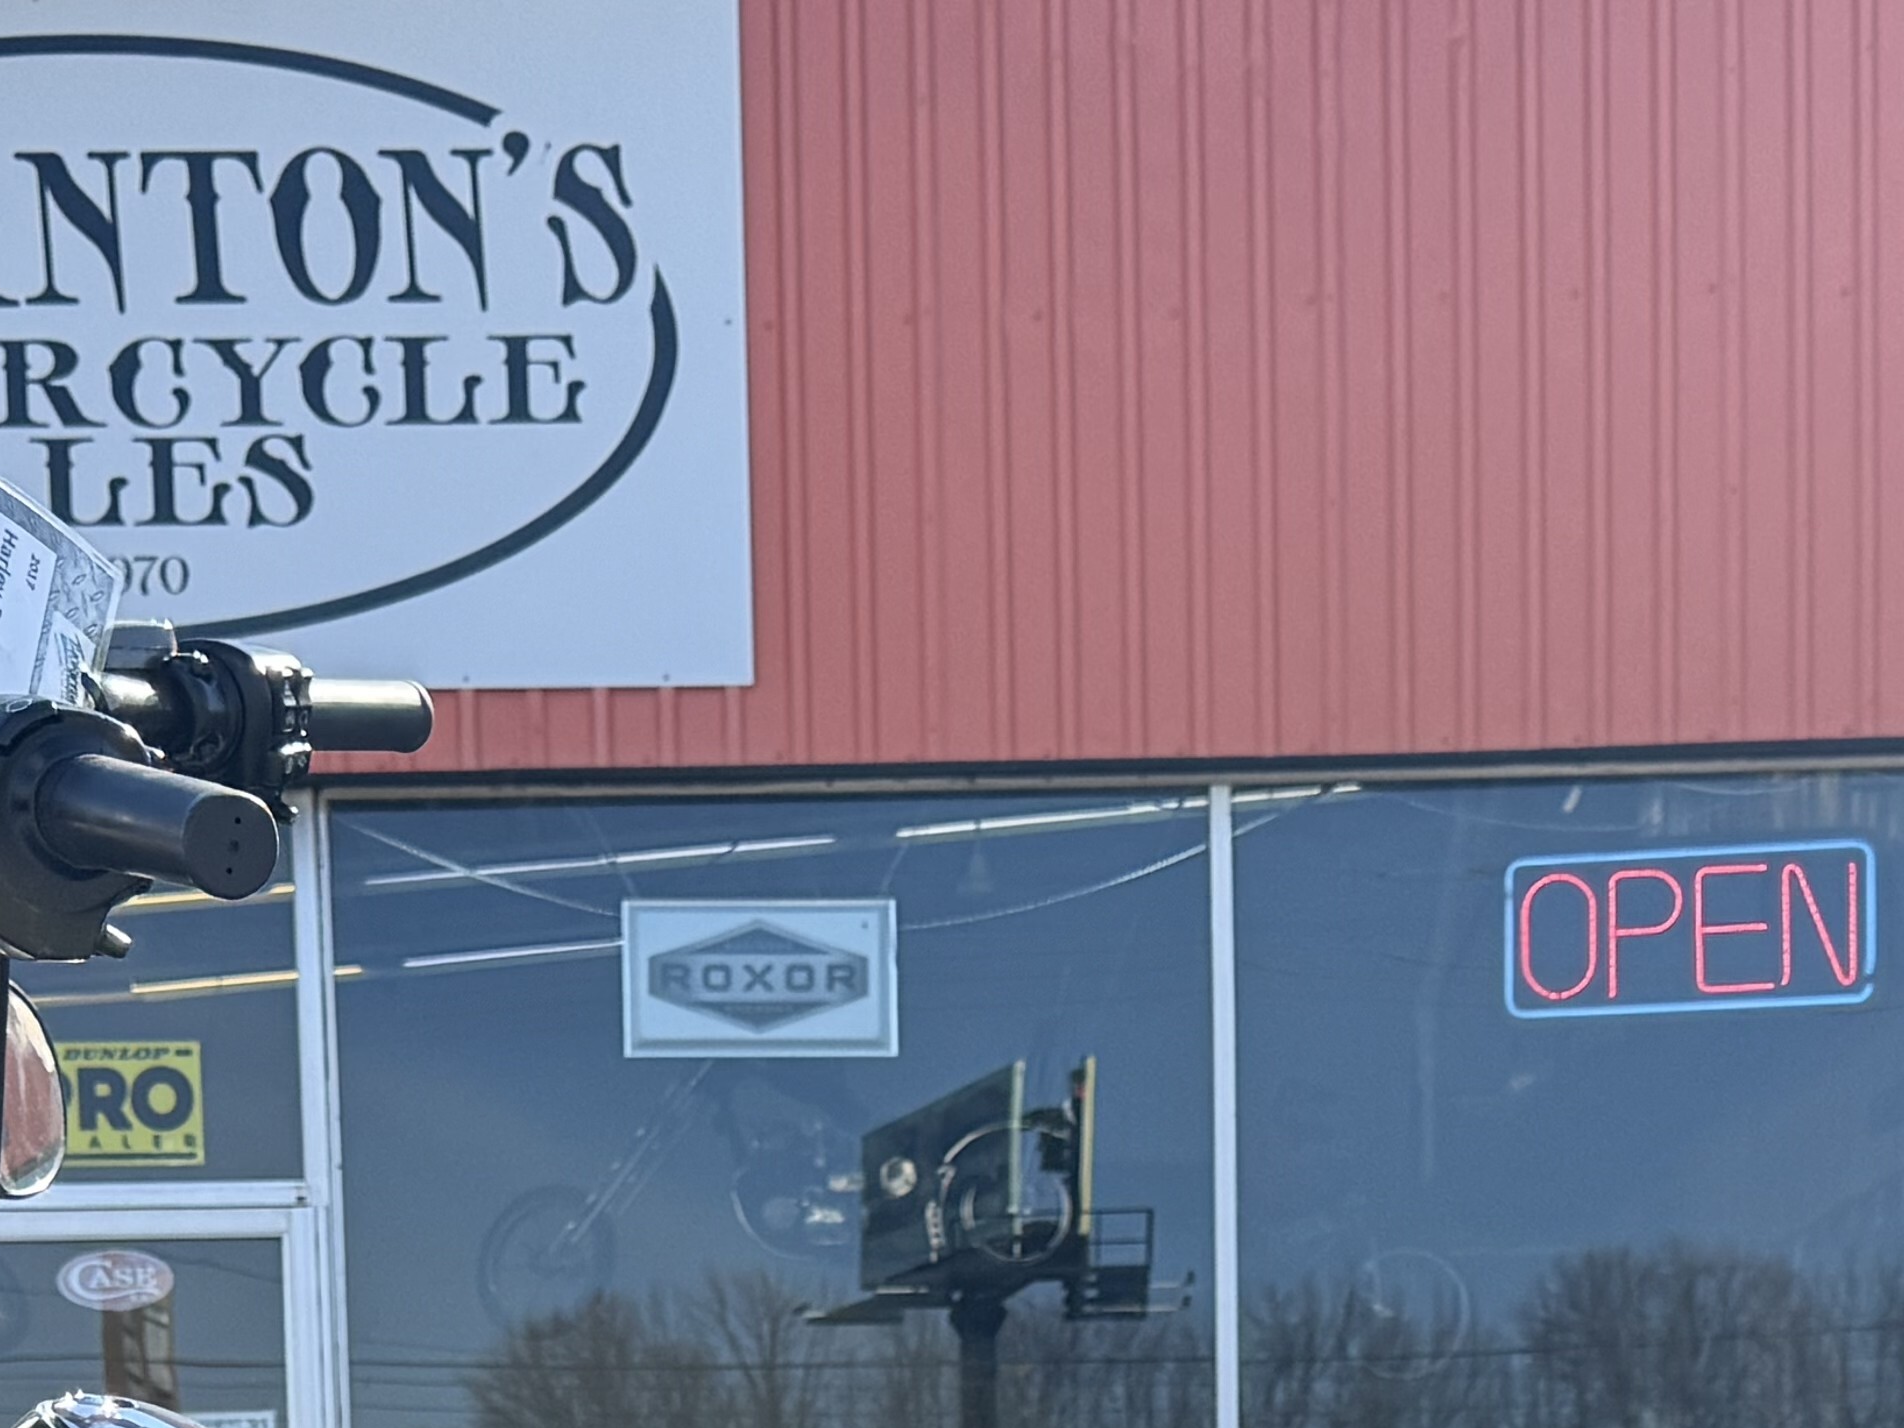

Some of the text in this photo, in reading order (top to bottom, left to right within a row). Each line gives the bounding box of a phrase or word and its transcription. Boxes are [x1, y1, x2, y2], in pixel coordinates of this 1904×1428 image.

[25, 553, 41, 591] 2017
[1520, 861, 1858, 1001] OPEN
[659, 962, 858, 993] ROXOR
[63, 1047, 171, 1061] DUNLOP
[67, 1260, 158, 1301] CASE
